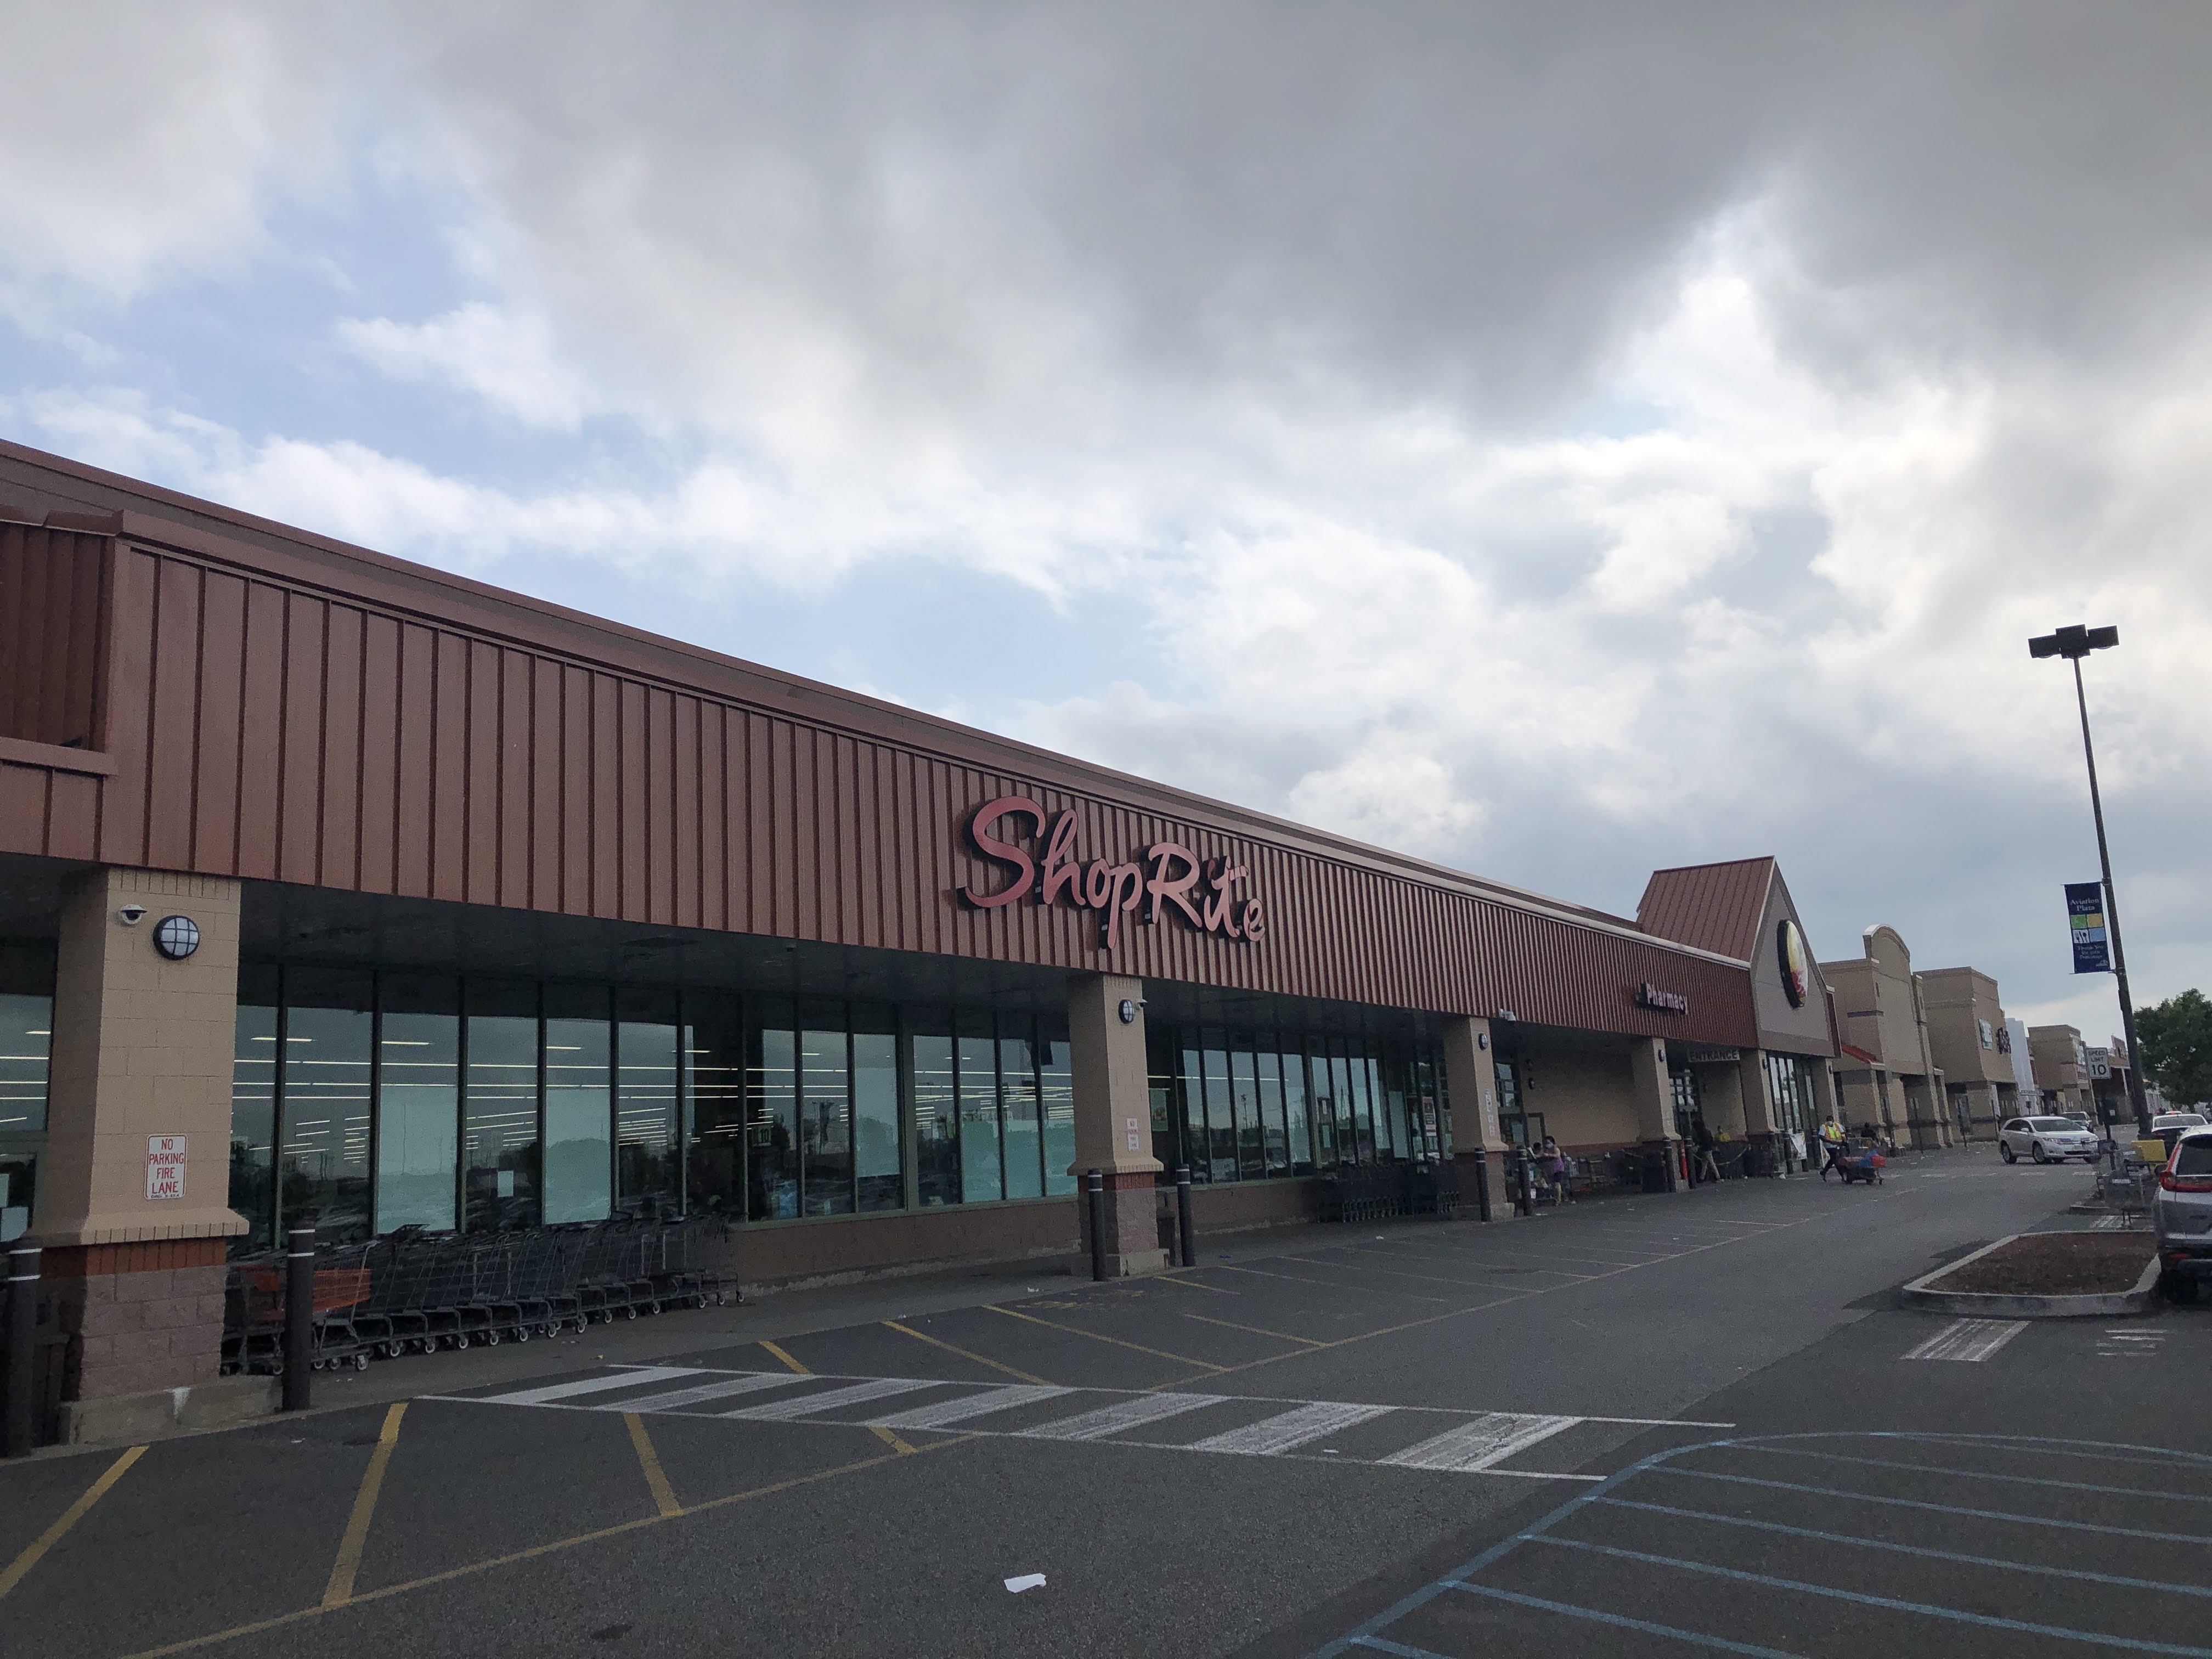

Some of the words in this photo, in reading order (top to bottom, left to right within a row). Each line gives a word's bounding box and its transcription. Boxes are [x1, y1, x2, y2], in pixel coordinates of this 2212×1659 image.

[964, 795, 1265, 949] ShopRite
[1646, 983, 1688, 1015] Pharmacy
[1690, 1051, 1738, 1061] ENTRANCE
[2092, 1064, 2107, 1075] 10
[161, 1138, 173, 1150] NO
[149, 1153, 184, 1165] PARKING
[156, 1167, 176, 1180] FIRE
[151, 1181, 179, 1194] LANE
